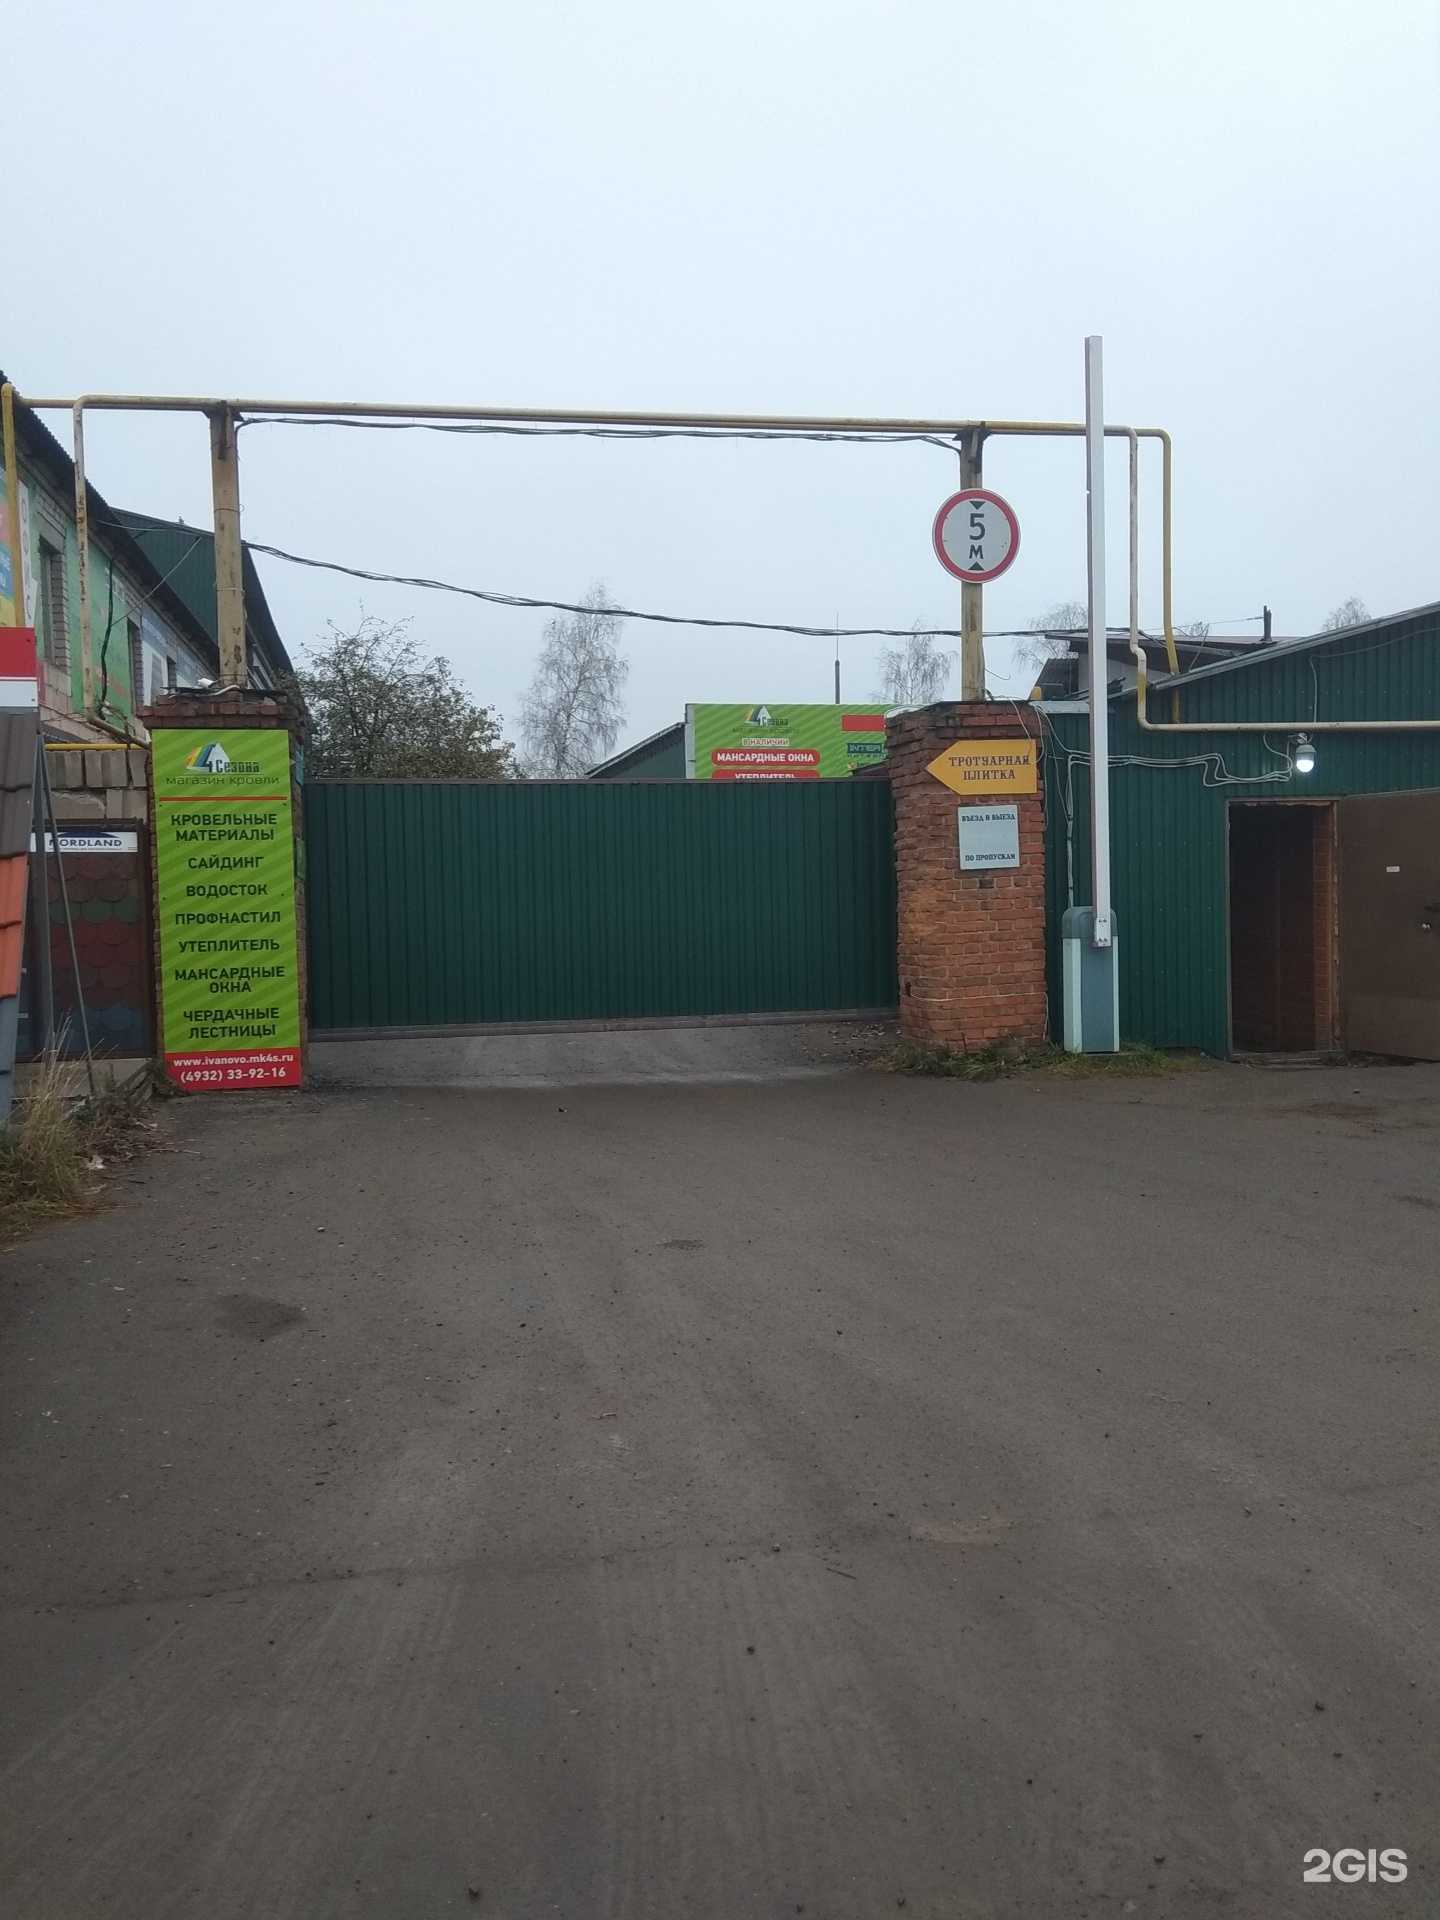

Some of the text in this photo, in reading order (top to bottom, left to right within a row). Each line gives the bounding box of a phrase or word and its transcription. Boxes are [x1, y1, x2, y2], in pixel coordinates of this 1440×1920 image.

[969, 512, 986, 541] 5
[717, 752, 815, 764] МАНСАРДНЫЕ ОКНА
[949, 755, 1030, 767] ТРОТУАРНАЯ
[216, 760, 260, 773] Сезона
[229, 775, 279, 787] кровли
[963, 769, 1016, 781] ПЛИТКА
[171, 814, 277, 826] КРОВЕЛЬНЫЕ
[176, 829, 274, 842] МАТЕРИАЛЫ
[188, 855, 264, 871] САЙДИНГ
[186, 884, 268, 898] ВОДОСТОК
[175, 911, 281, 925] ПРОФНАСТИЛ
[179, 939, 280, 953] УТЕПЛИТЕЛЬ
[175, 966, 285, 981] МАНСАРДНЫЕ
[209, 981, 252, 994] ОКНА
[183, 1007, 280, 1023] ЧЕРДАЧНЫЕ
[188, 1024, 276, 1039] ЛЕСТНИЦЫ
[173, 1053, 294, 1067] www.ivanovo.mk4s.ru
[180, 1067, 286, 1083] (4932) 33-92-16
